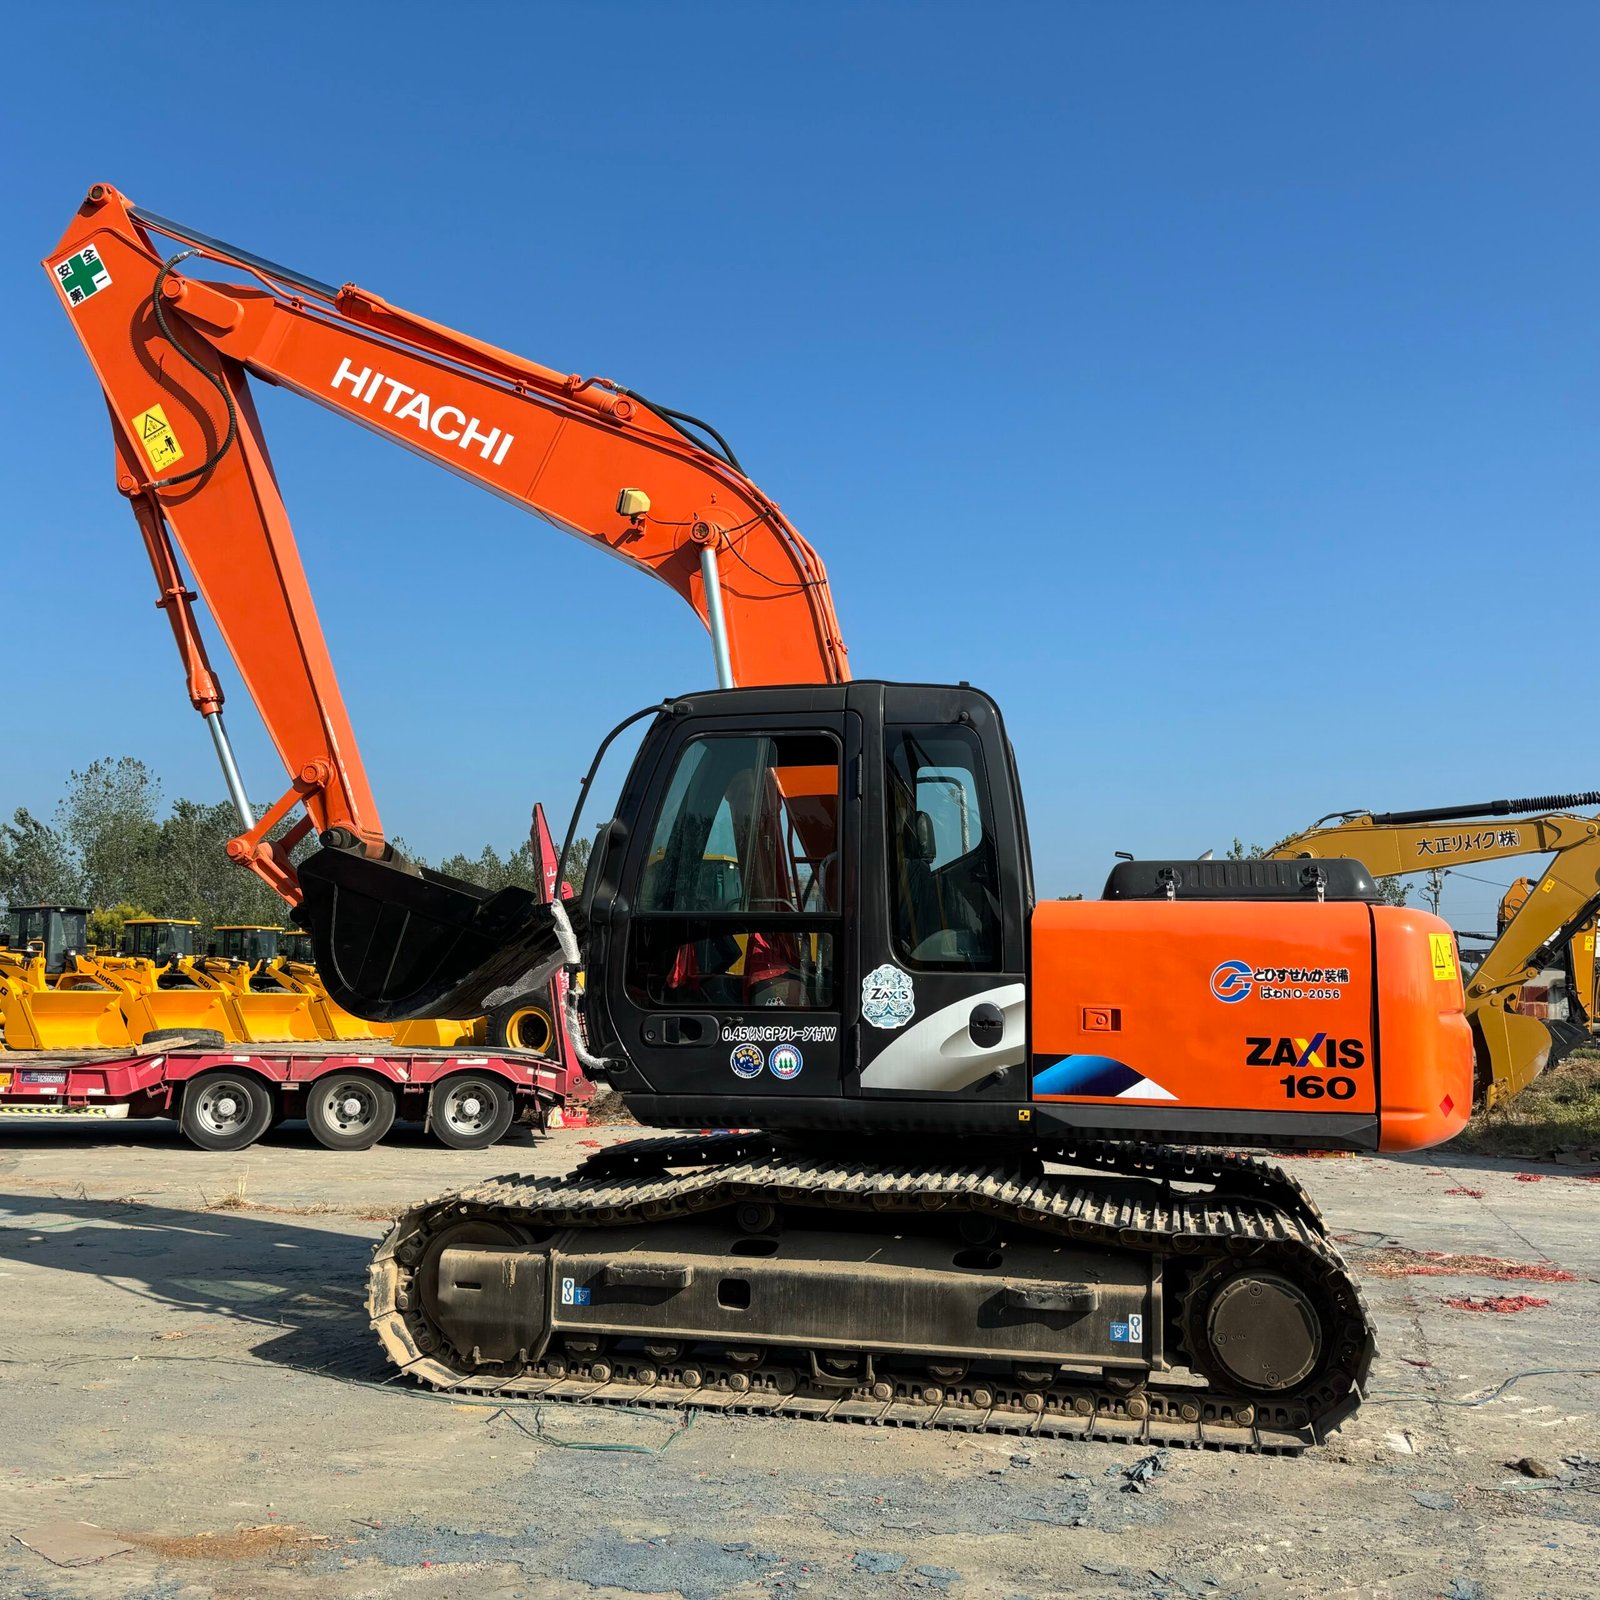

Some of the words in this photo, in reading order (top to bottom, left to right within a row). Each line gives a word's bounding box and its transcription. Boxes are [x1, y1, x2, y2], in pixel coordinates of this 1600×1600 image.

[330, 357, 515, 466] HITACHI
[870, 987, 909, 1001] ZAXIS
[1245, 1032, 1365, 1069] ZAXIS
[1279, 1074, 1357, 1100] 160
